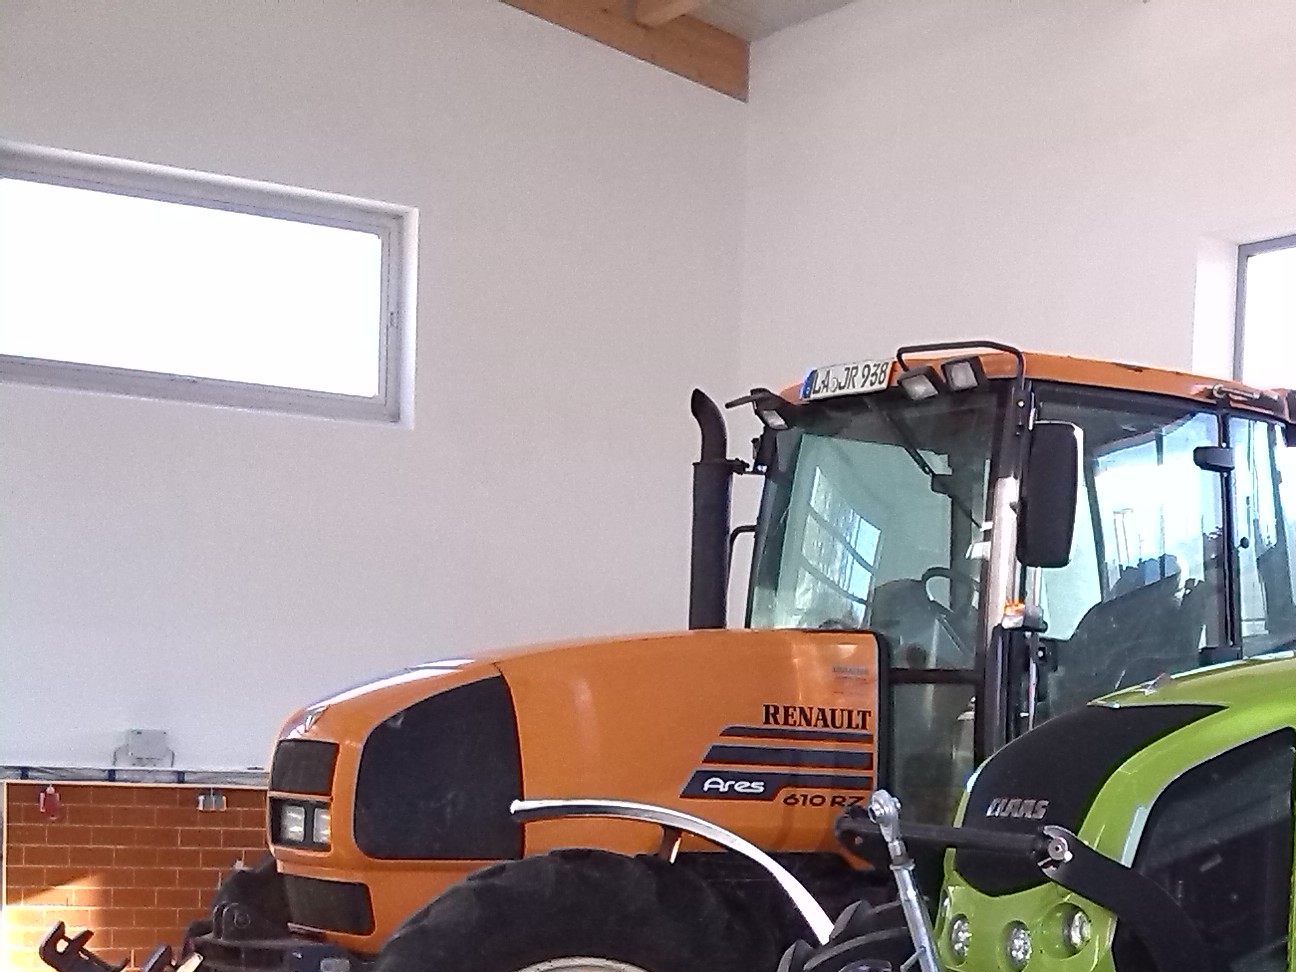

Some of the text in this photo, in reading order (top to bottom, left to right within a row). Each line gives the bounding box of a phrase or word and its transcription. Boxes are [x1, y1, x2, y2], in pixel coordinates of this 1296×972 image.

[812, 361, 889, 395] LA JR 938
[763, 703, 872, 730] RENAULT
[703, 777, 765, 793] Ares
[783, 794, 827, 807] 610
[986, 798, 1050, 819] CLAAS
